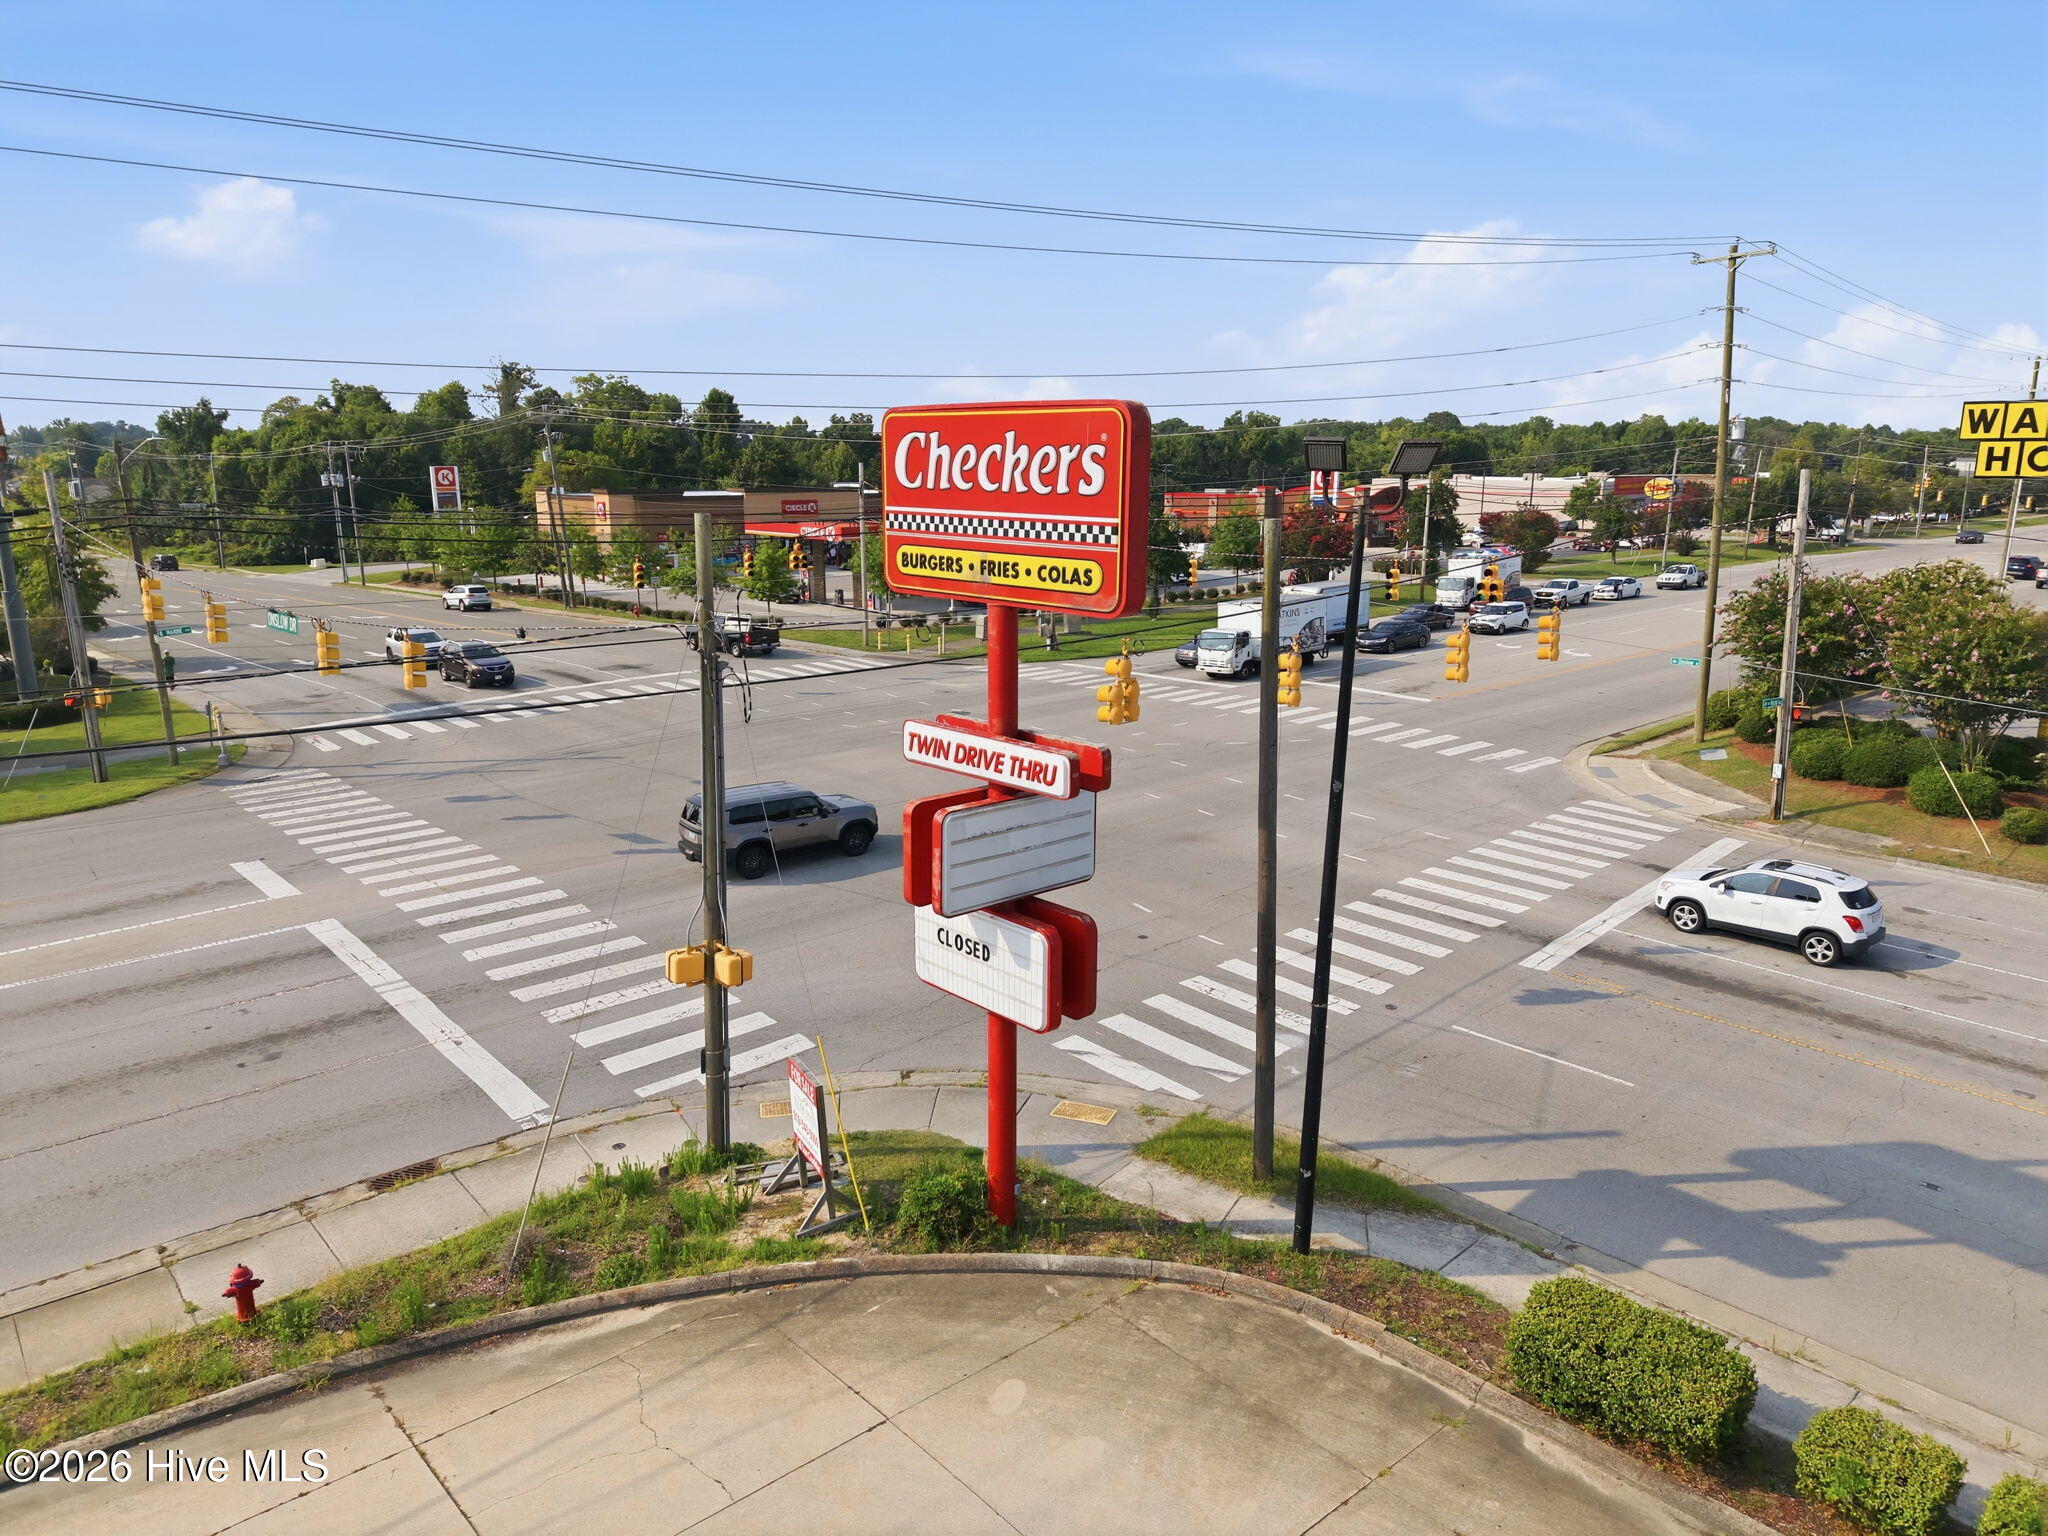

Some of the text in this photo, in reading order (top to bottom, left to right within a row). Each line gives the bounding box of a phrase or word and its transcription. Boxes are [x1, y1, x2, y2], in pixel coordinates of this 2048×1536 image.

[893, 430, 1107, 497] Checkers
[900, 551, 1094, 587] BURGERS FRIES COLAS
[267, 610, 289, 630] ONSLOW
[907, 731, 1059, 787] TWIN DRIVE THRU
[937, 926, 991, 963] CLOSED
